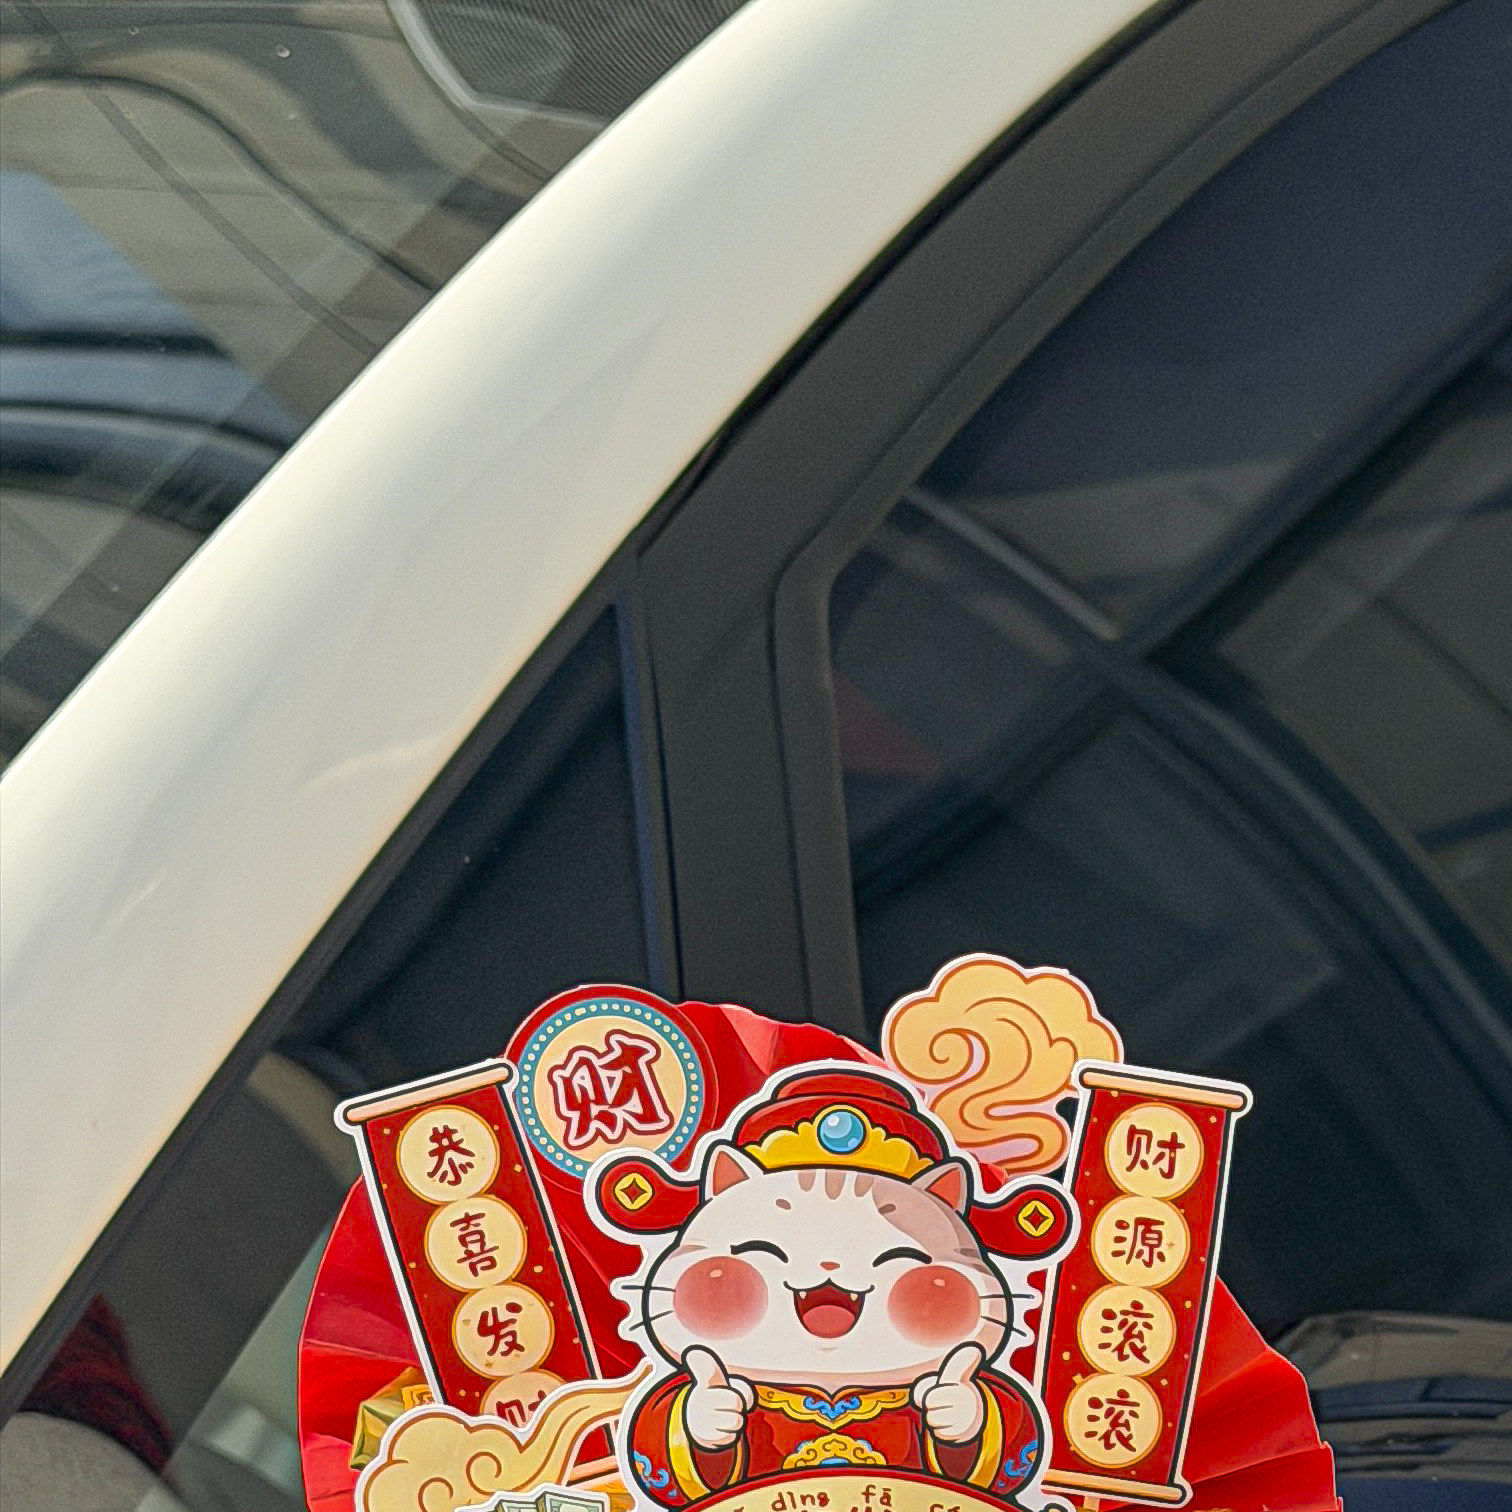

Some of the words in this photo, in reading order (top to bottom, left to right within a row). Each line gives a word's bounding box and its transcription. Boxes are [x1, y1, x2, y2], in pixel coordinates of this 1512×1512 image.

[550, 1030, 674, 1148] 财
[1085, 1123, 1186, 1455] 财源滚滚
